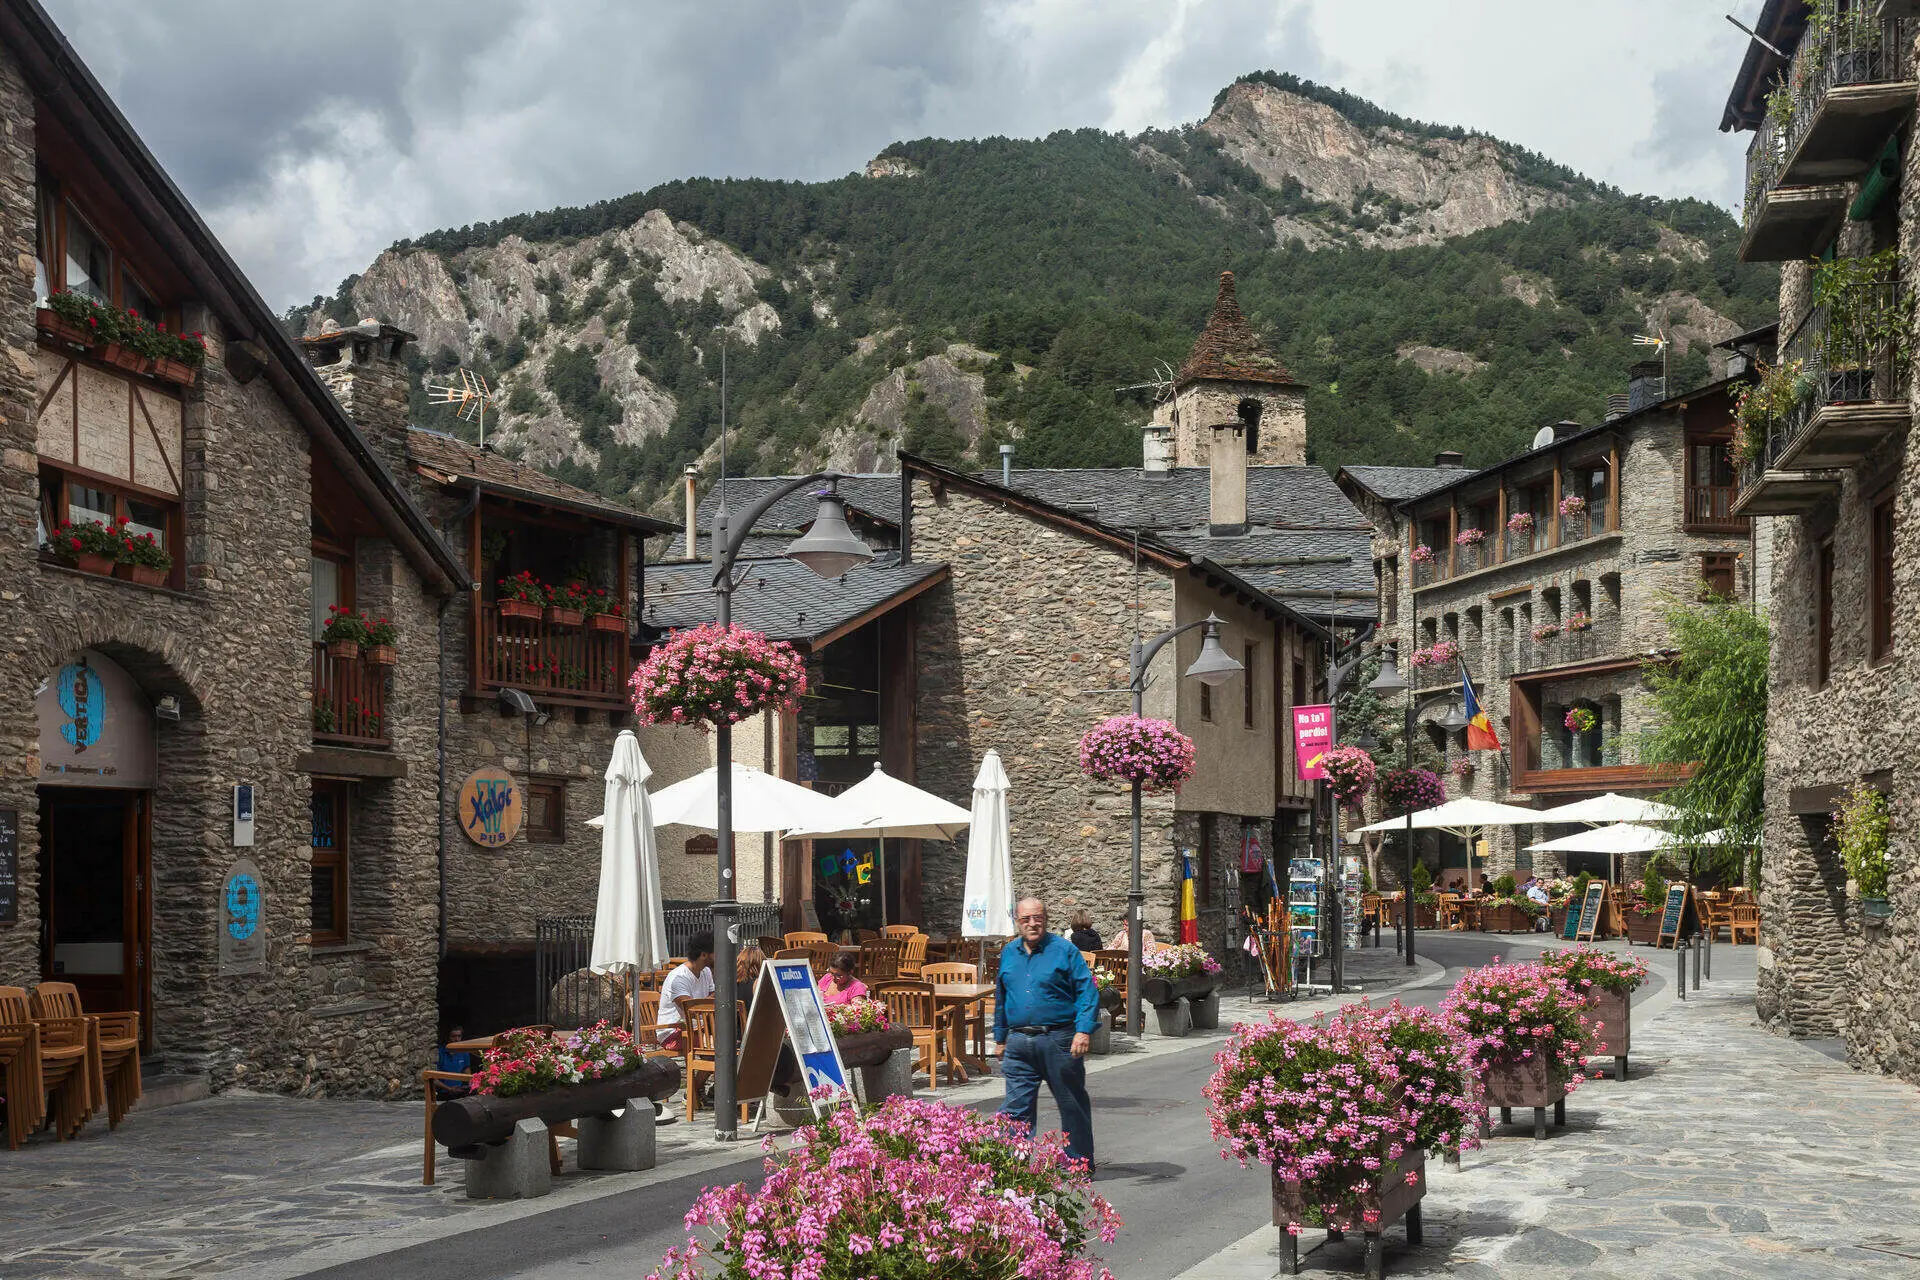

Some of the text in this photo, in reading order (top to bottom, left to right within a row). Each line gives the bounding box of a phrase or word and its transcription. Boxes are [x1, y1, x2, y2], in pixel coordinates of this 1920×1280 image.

[75, 656, 88, 754] VERTICAL
[1298, 714, 1309, 724] No
[1299, 726, 1328, 739] perdis!
[480, 832, 506, 844] PUB
[227, 873, 260, 940] 9
